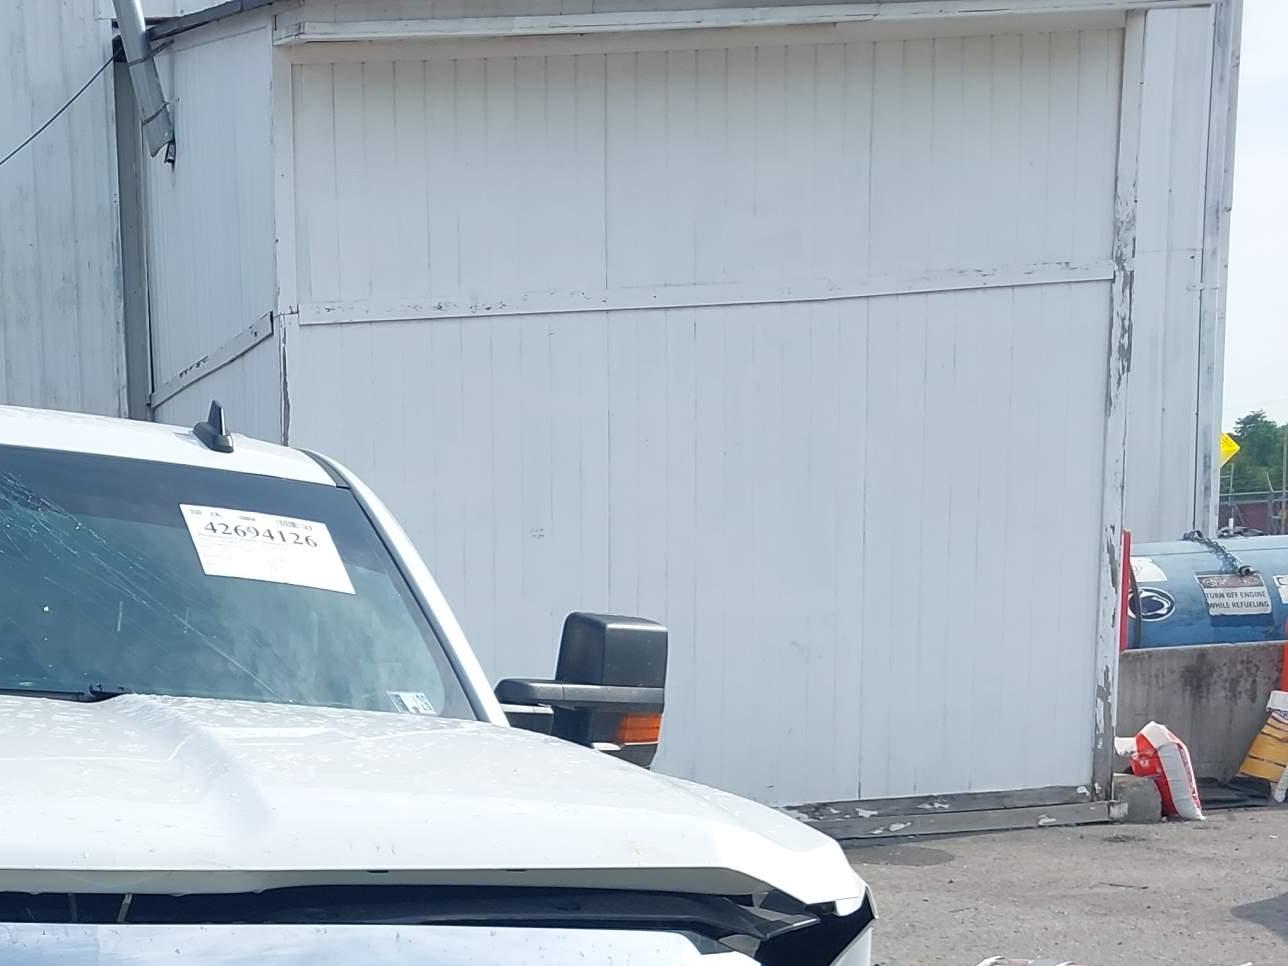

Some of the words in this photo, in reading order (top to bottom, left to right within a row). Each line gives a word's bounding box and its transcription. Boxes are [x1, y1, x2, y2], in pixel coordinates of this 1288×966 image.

[204, 521, 318, 548] 42694126
[1206, 591, 1225, 599] TURN
[1240, 590, 1266, 598] ENGINE
[1208, 601, 1230, 609] WHILE
[1232, 600, 1269, 608] REFUELING
